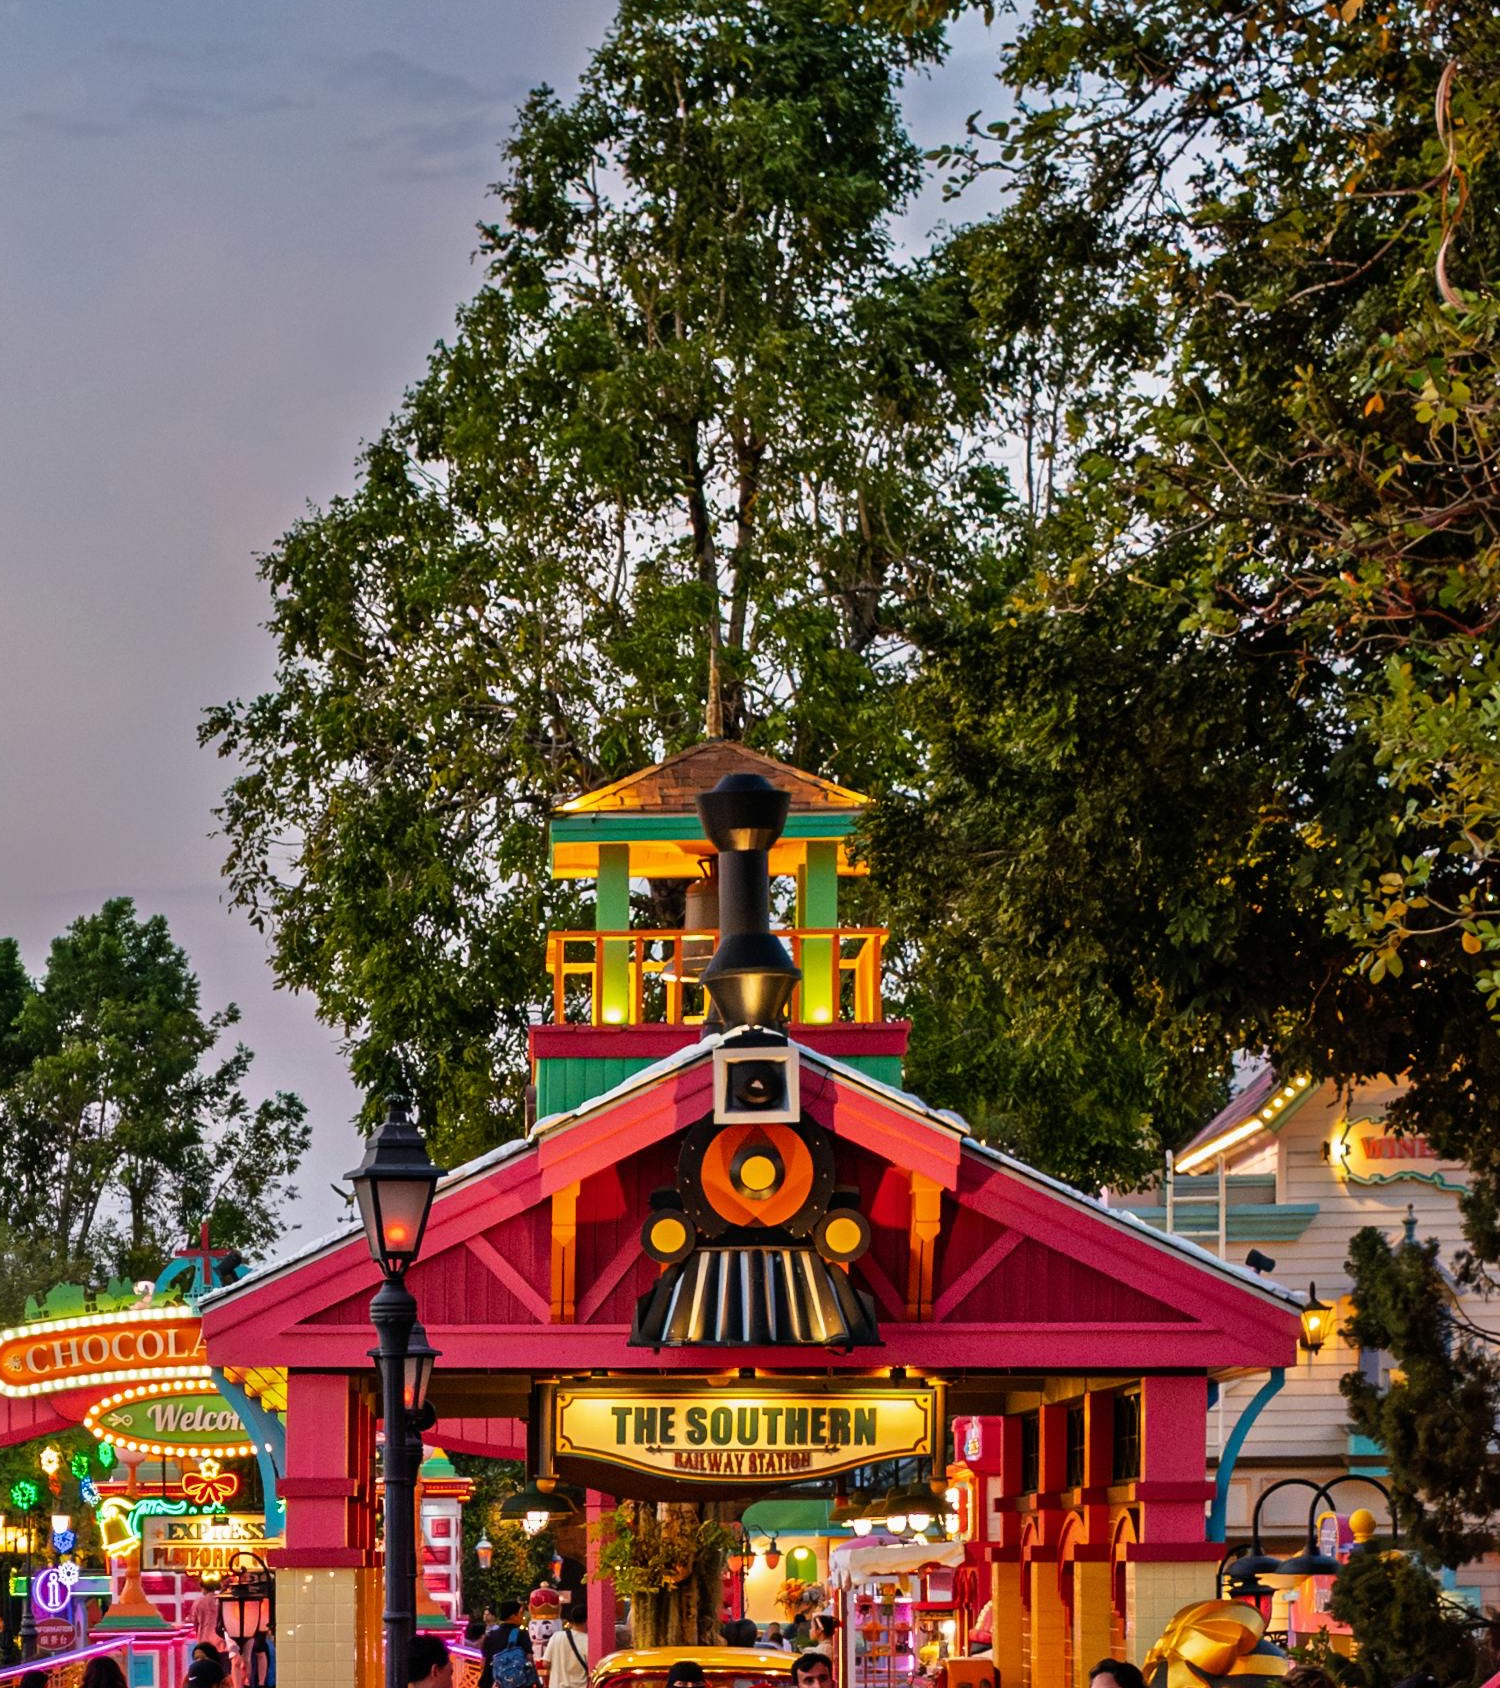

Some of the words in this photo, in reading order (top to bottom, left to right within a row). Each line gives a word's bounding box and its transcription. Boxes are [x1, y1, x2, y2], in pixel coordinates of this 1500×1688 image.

[611, 1406, 676, 1445] THE
[686, 1406, 878, 1446] SOUTHERN
[674, 1452, 745, 1474] RAILWAY
[748, 1452, 813, 1473] STATION
